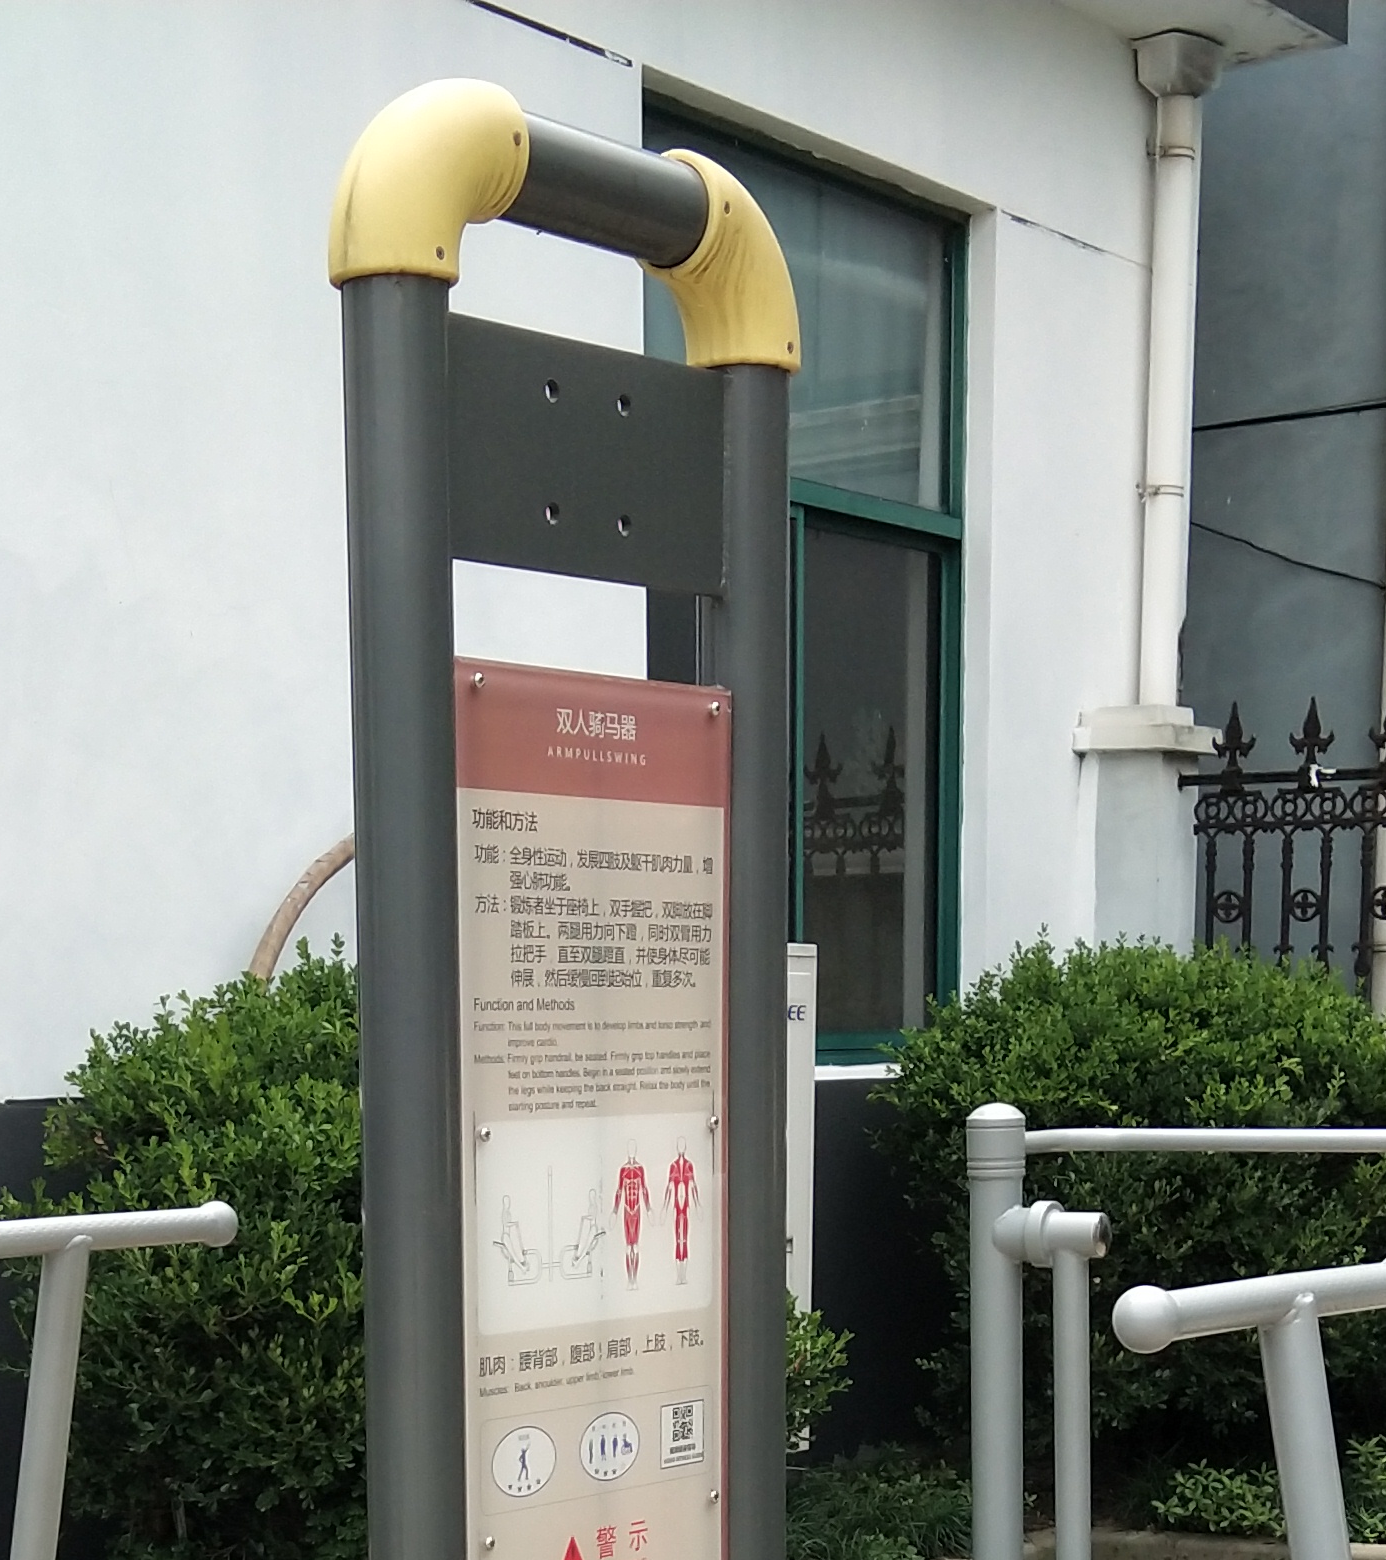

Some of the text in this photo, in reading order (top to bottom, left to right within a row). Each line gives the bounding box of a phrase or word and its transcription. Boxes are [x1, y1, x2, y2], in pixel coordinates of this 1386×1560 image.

[556, 707, 637, 741] 双人骑马器
[547, 745, 647, 766] ARMPULLSWING
[471, 808, 538, 833] 功能和方法
[473, 997, 575, 1012] Function and Methods
[596, 1519, 649, 1560] 警示
